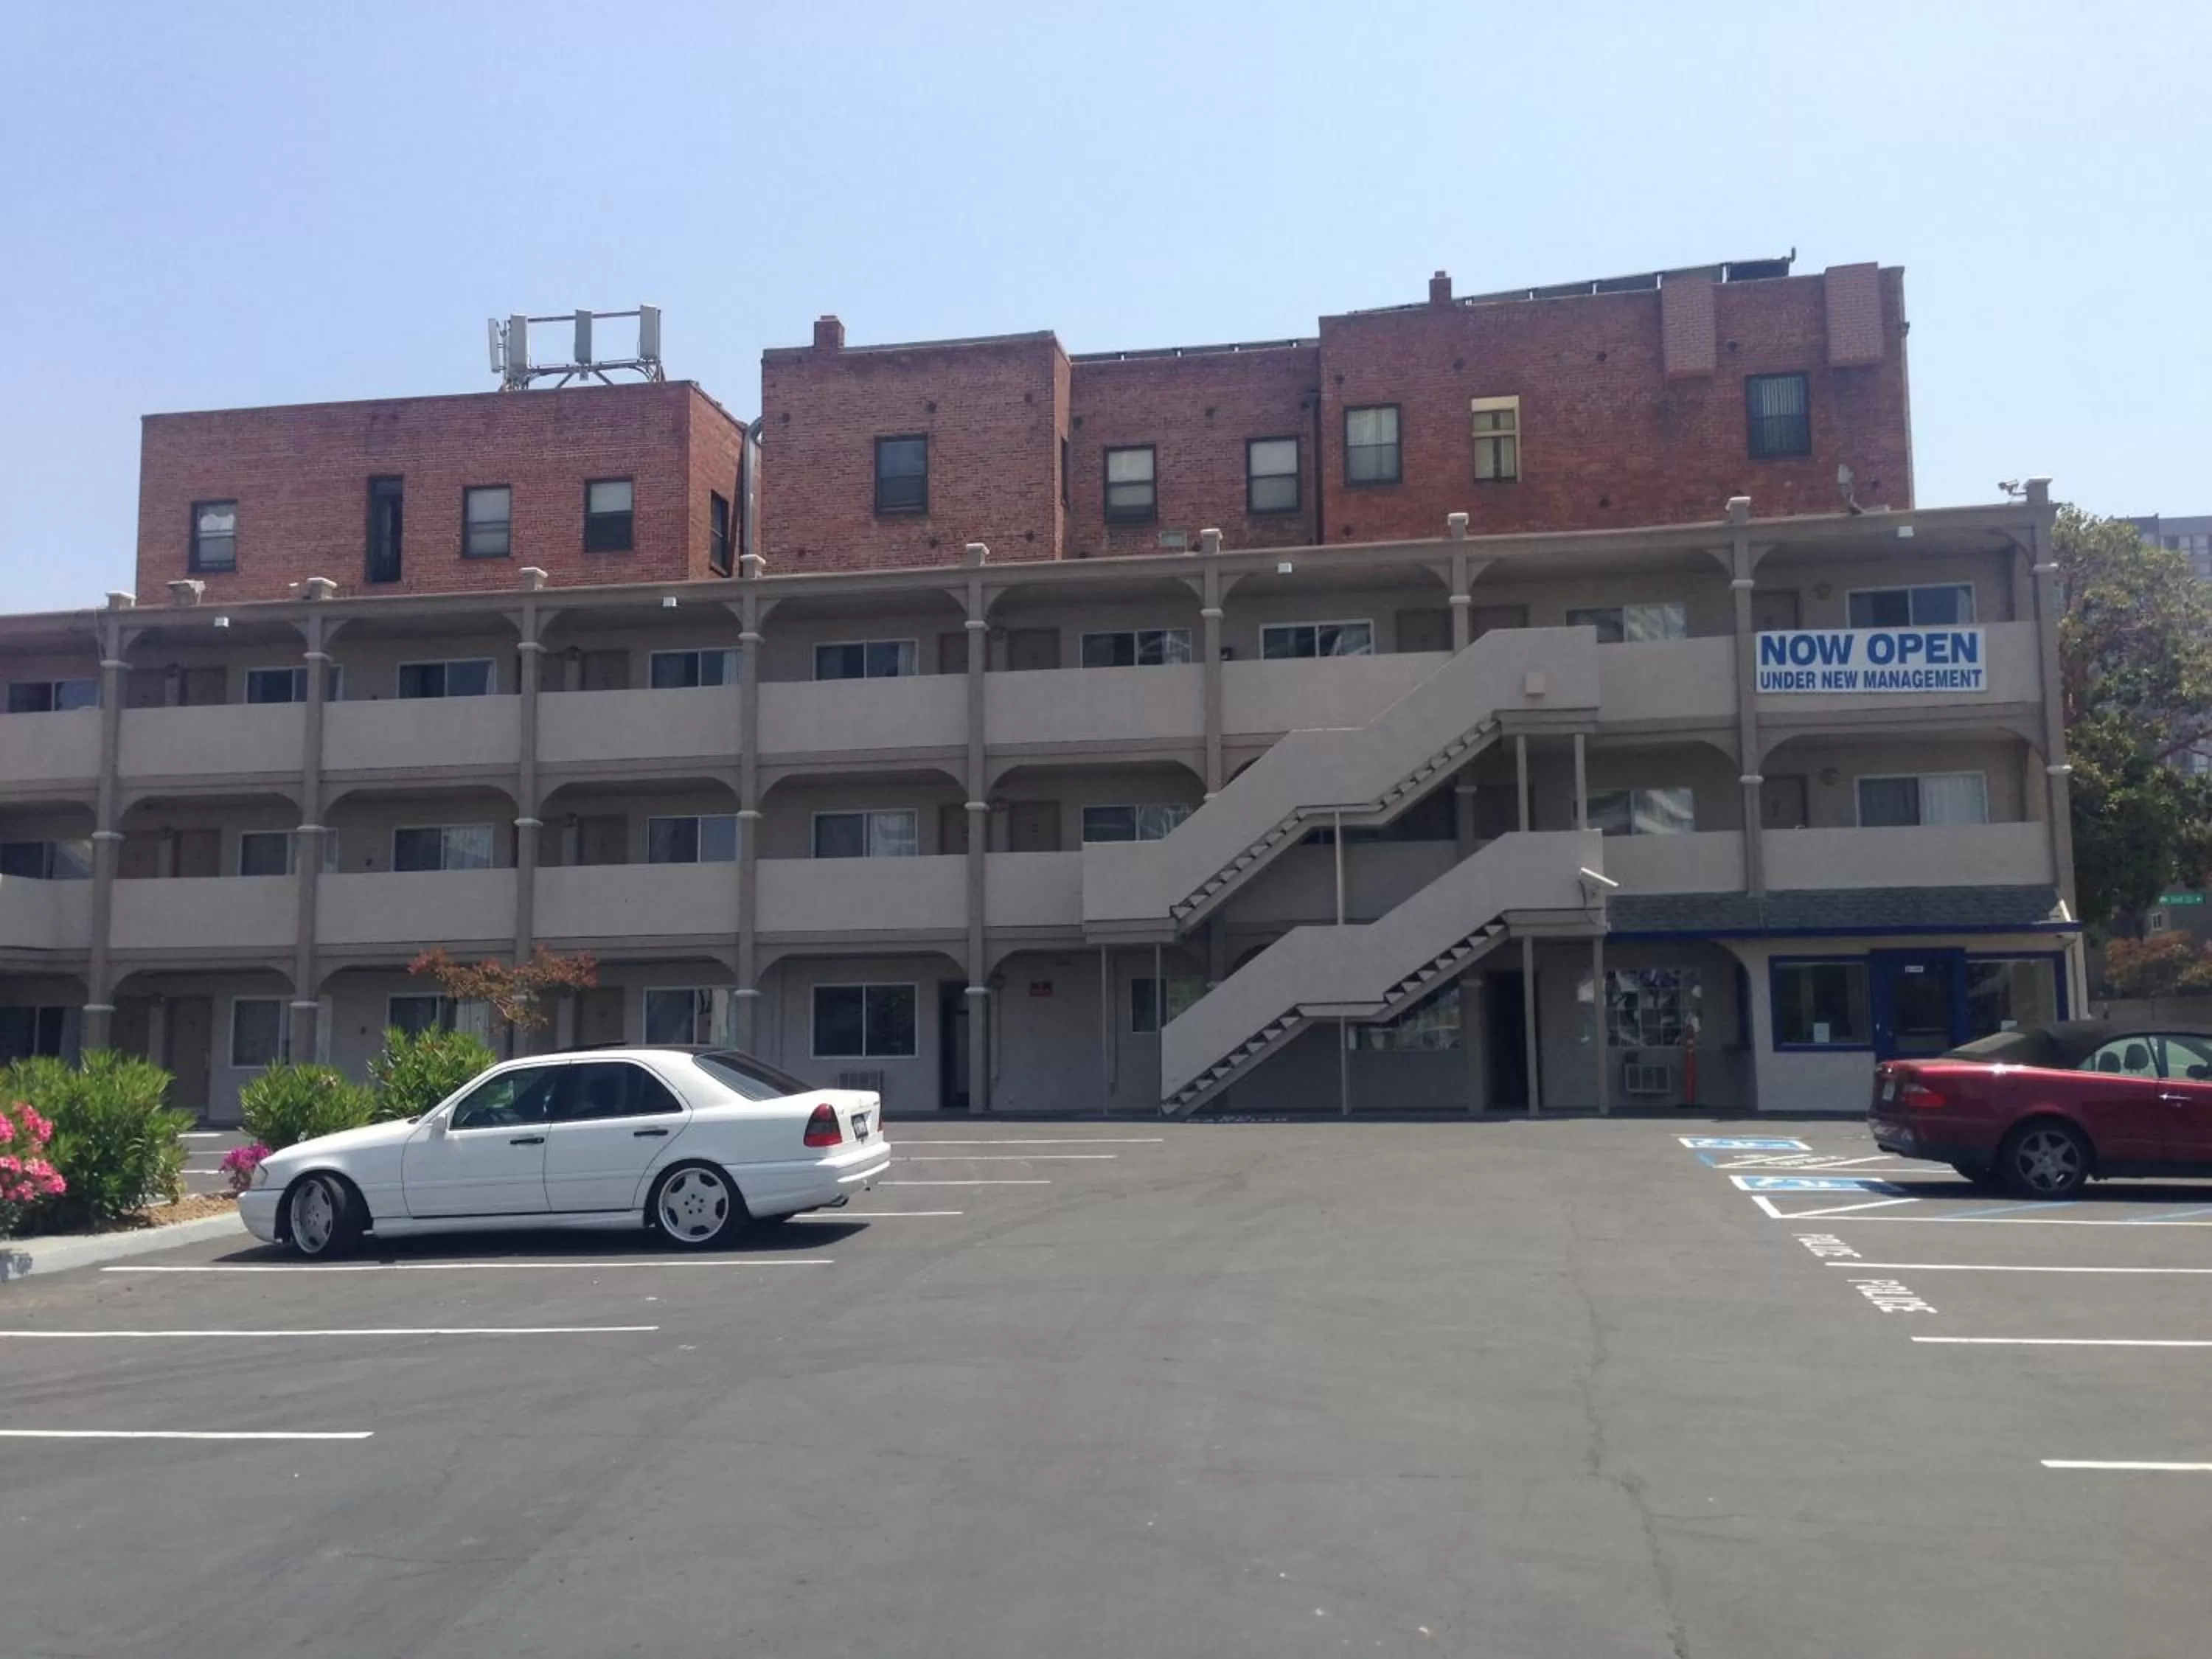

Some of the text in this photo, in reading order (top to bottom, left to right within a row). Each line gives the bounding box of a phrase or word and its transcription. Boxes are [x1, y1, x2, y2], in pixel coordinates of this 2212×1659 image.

[1761, 632, 1978, 666] NOW OPEN
[1760, 669, 1983, 689] UNDER NEW MANAGEMENT
